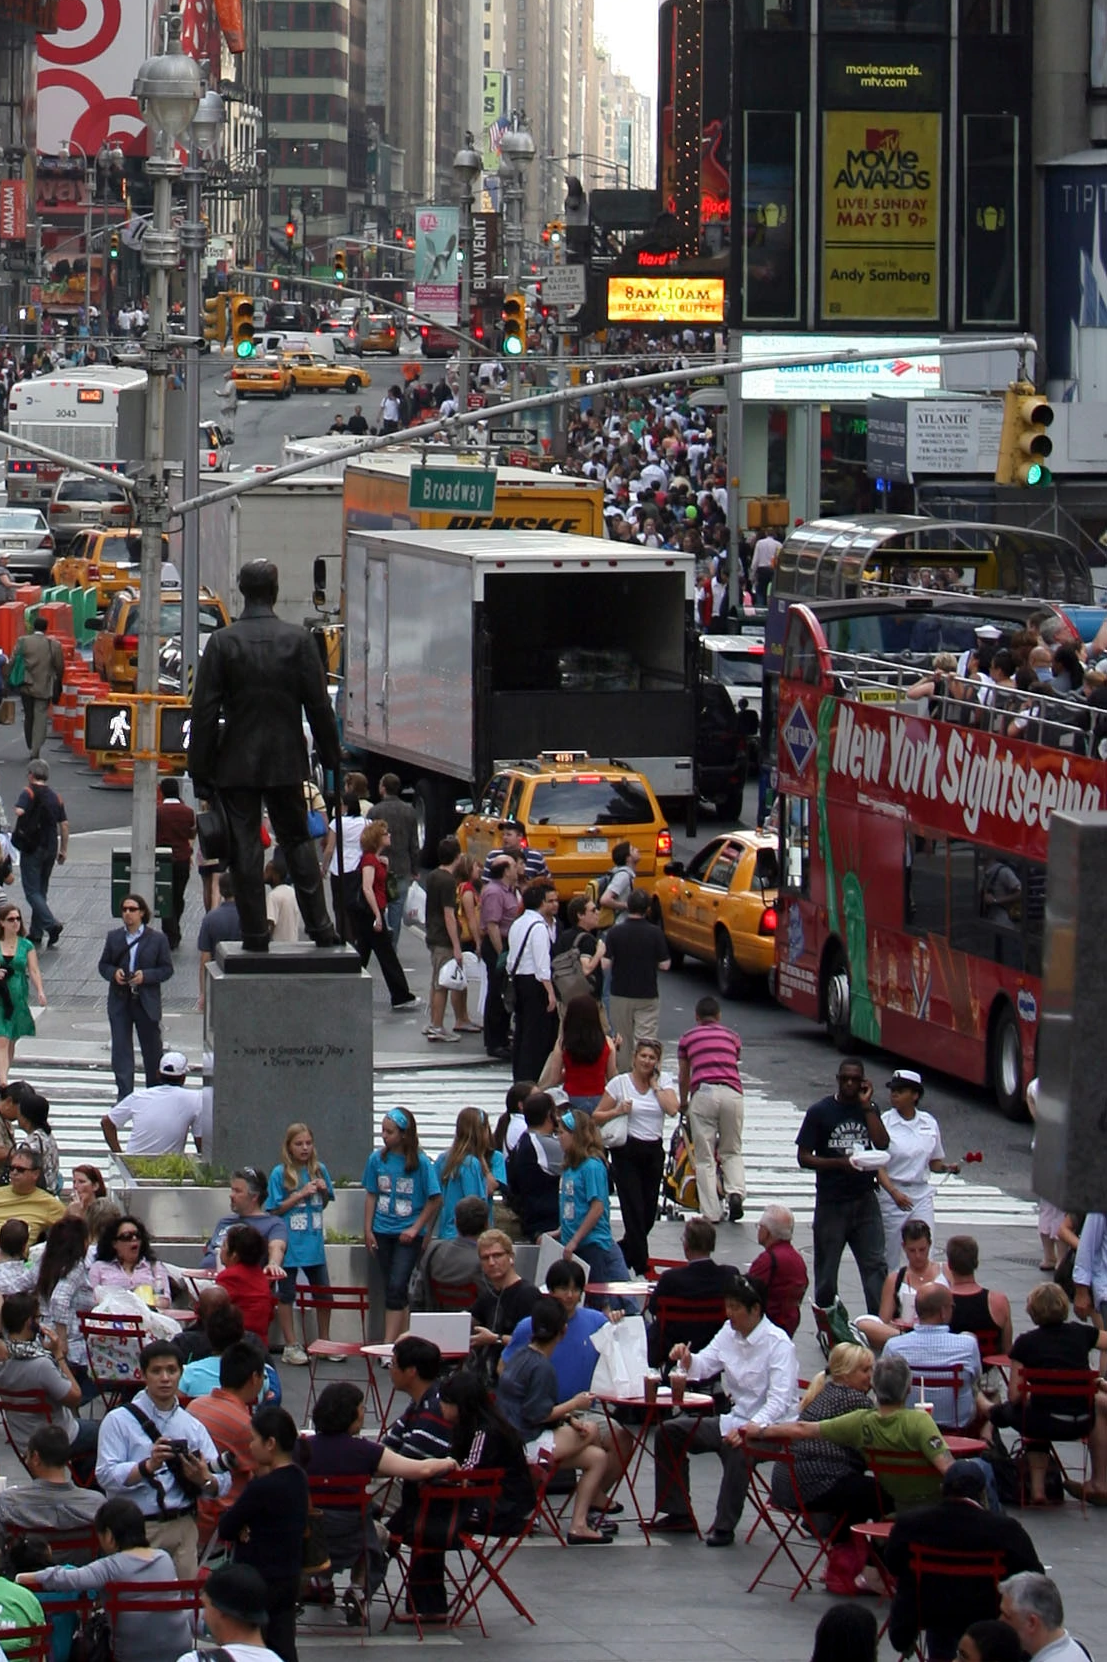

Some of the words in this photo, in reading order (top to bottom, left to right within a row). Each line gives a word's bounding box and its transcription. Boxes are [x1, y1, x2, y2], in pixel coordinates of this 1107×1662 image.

[860, 77, 907, 87] mtv.com
[833, 169, 930, 190] AWARDS
[4, 187, 14, 236] JAMJAM
[837, 198, 868, 209] LIVE!
[873, 199, 928, 210] SUNDAY
[837, 212, 876, 226] MAY
[881, 212, 899, 227] 31
[473, 218, 486, 258] VENIT
[638, 251, 667, 266] Hard
[473, 260, 487, 290] BUN
[830, 269, 865, 283] Andy
[869, 269, 930, 284] Samberg
[618, 304, 675, 313] BREAKFAST
[679, 304, 716, 313] BUFFET
[827, 361, 879, 374] America
[917, 414, 970, 424] ATLANTIC
[423, 478, 485, 508] Broadway
[833, 703, 885, 784] New
[888, 716, 941, 800] York
